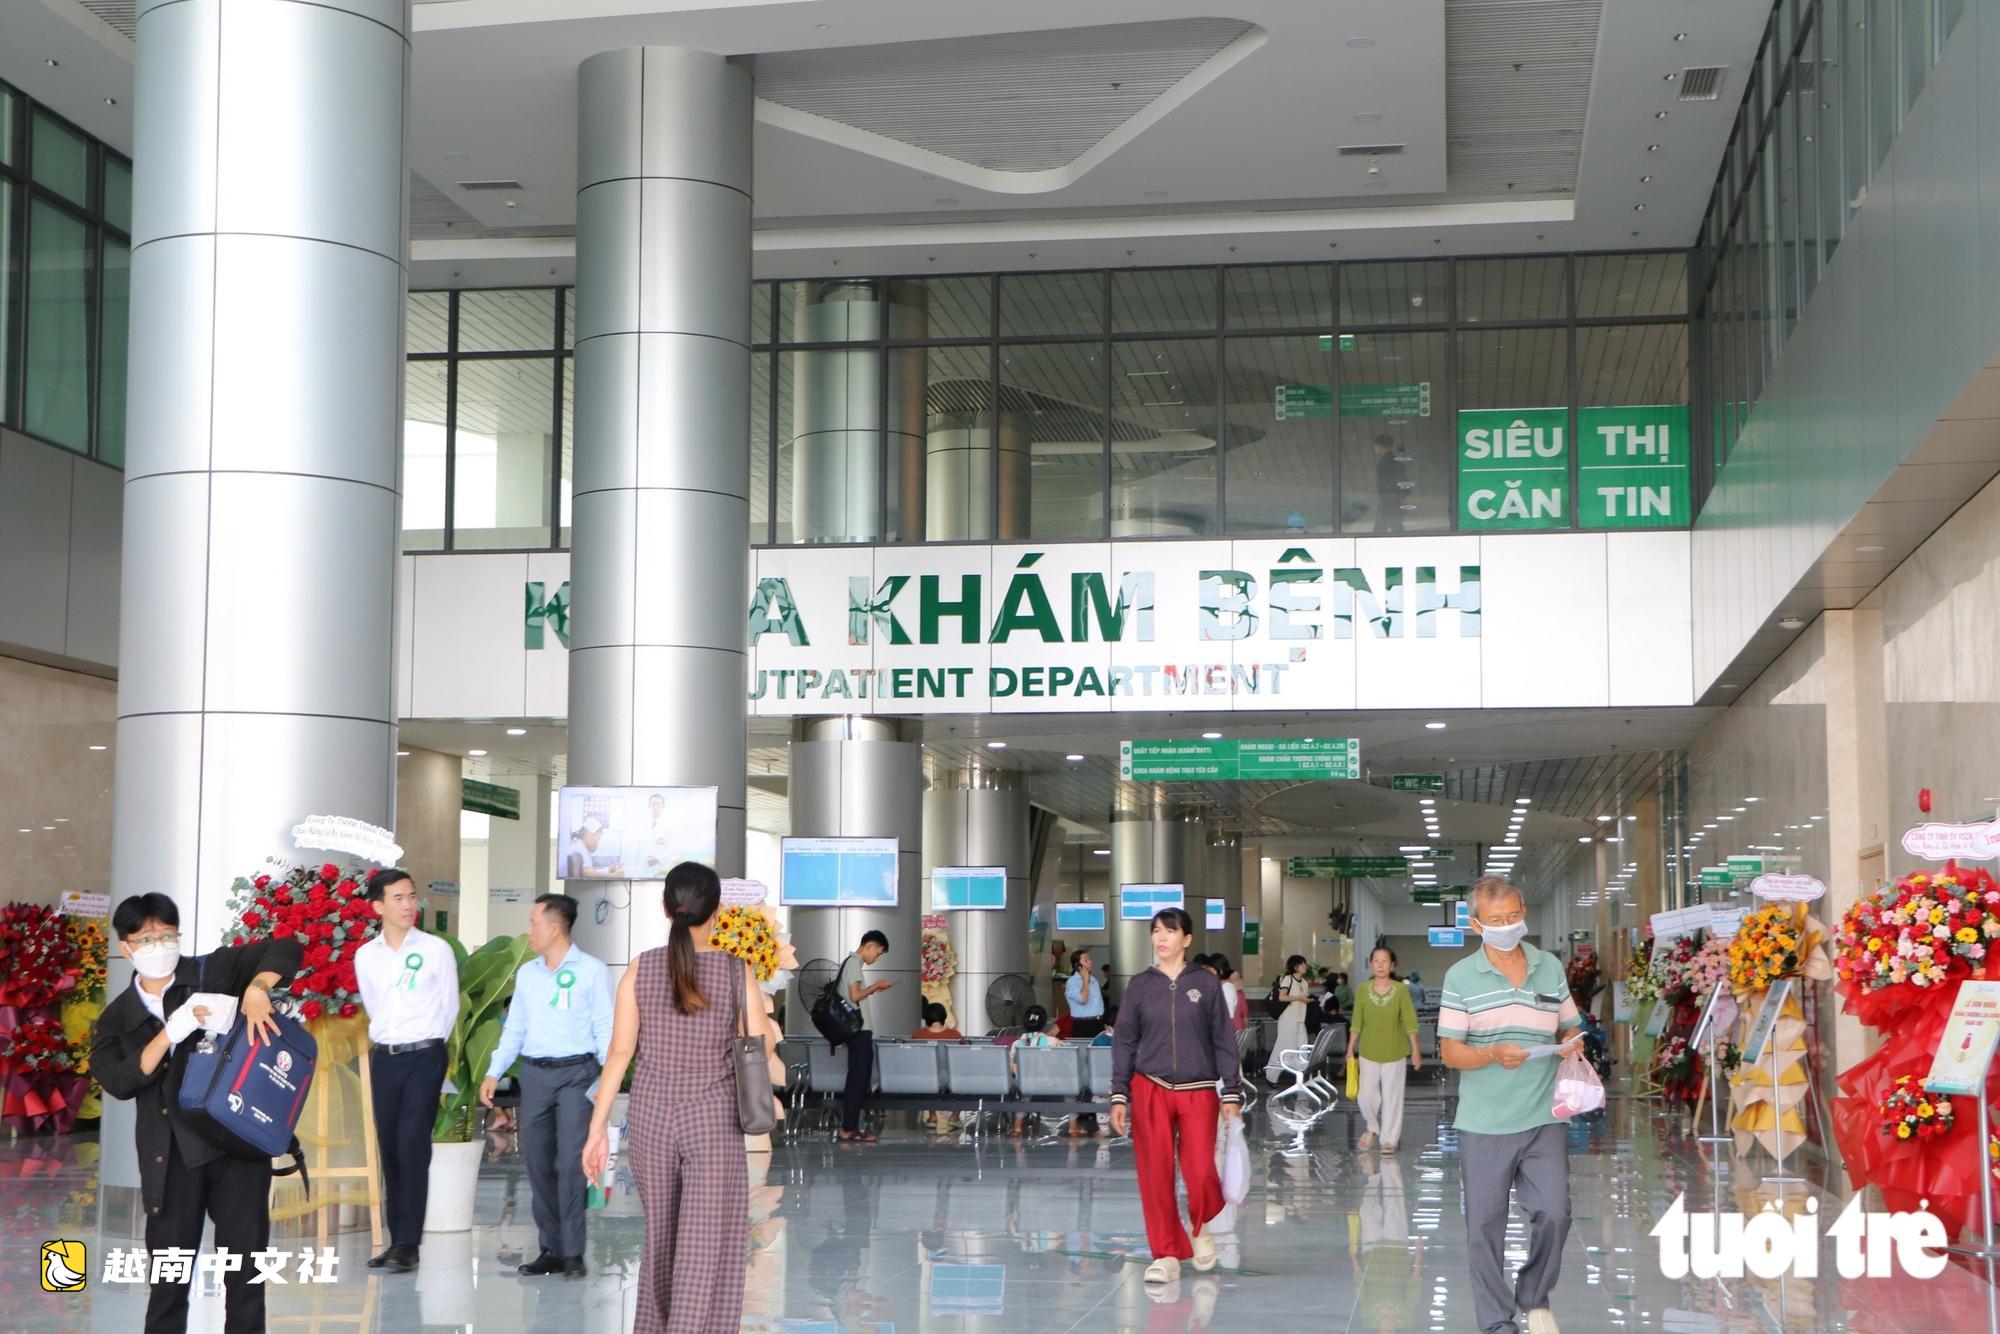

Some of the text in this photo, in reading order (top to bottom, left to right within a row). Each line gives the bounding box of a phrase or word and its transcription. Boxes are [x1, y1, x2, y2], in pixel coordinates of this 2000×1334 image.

[1464, 419, 1670, 463] SIÊU THỊ
[1467, 480, 1671, 520] CĂN TIN
[524, 548, 1481, 662] KA KHÁM BỆNH
[748, 664, 1289, 700] UTPATIENT DEPARTMENT
[1404, 776, 1419, 787] WC
